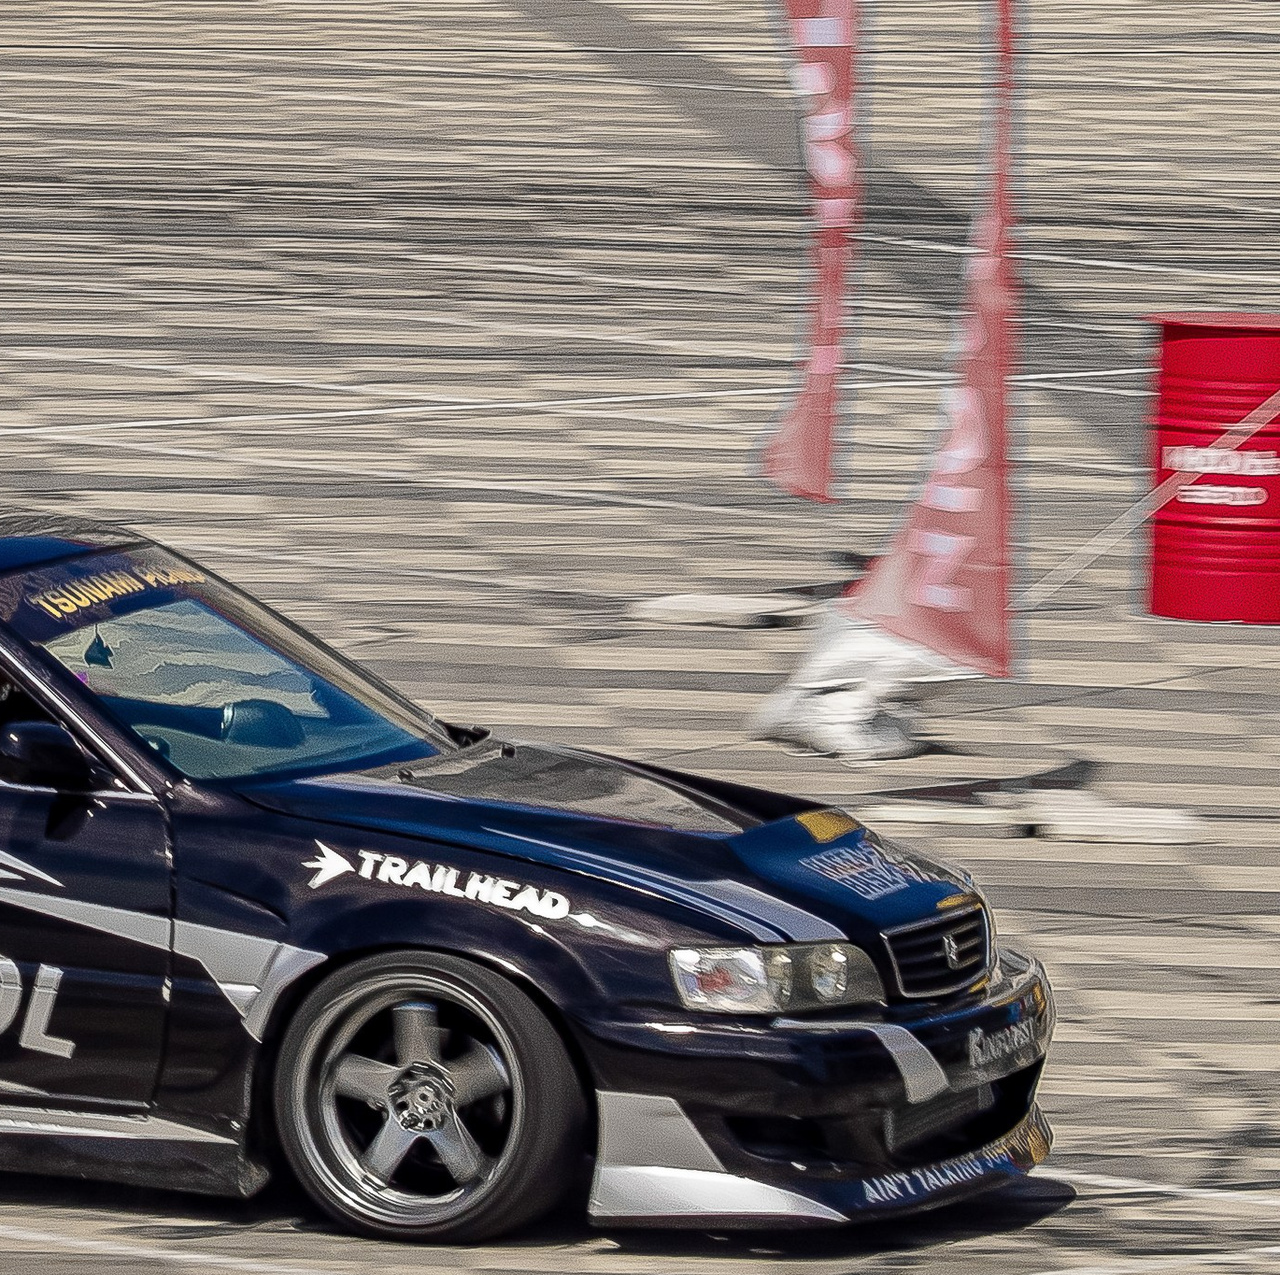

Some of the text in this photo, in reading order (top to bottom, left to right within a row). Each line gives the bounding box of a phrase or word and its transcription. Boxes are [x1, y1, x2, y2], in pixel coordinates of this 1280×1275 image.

[28, 570, 145, 618] TSUNAMI
[357, 849, 569, 920] TRAILHEAD
[862, 1172, 917, 1203] AIN'T
